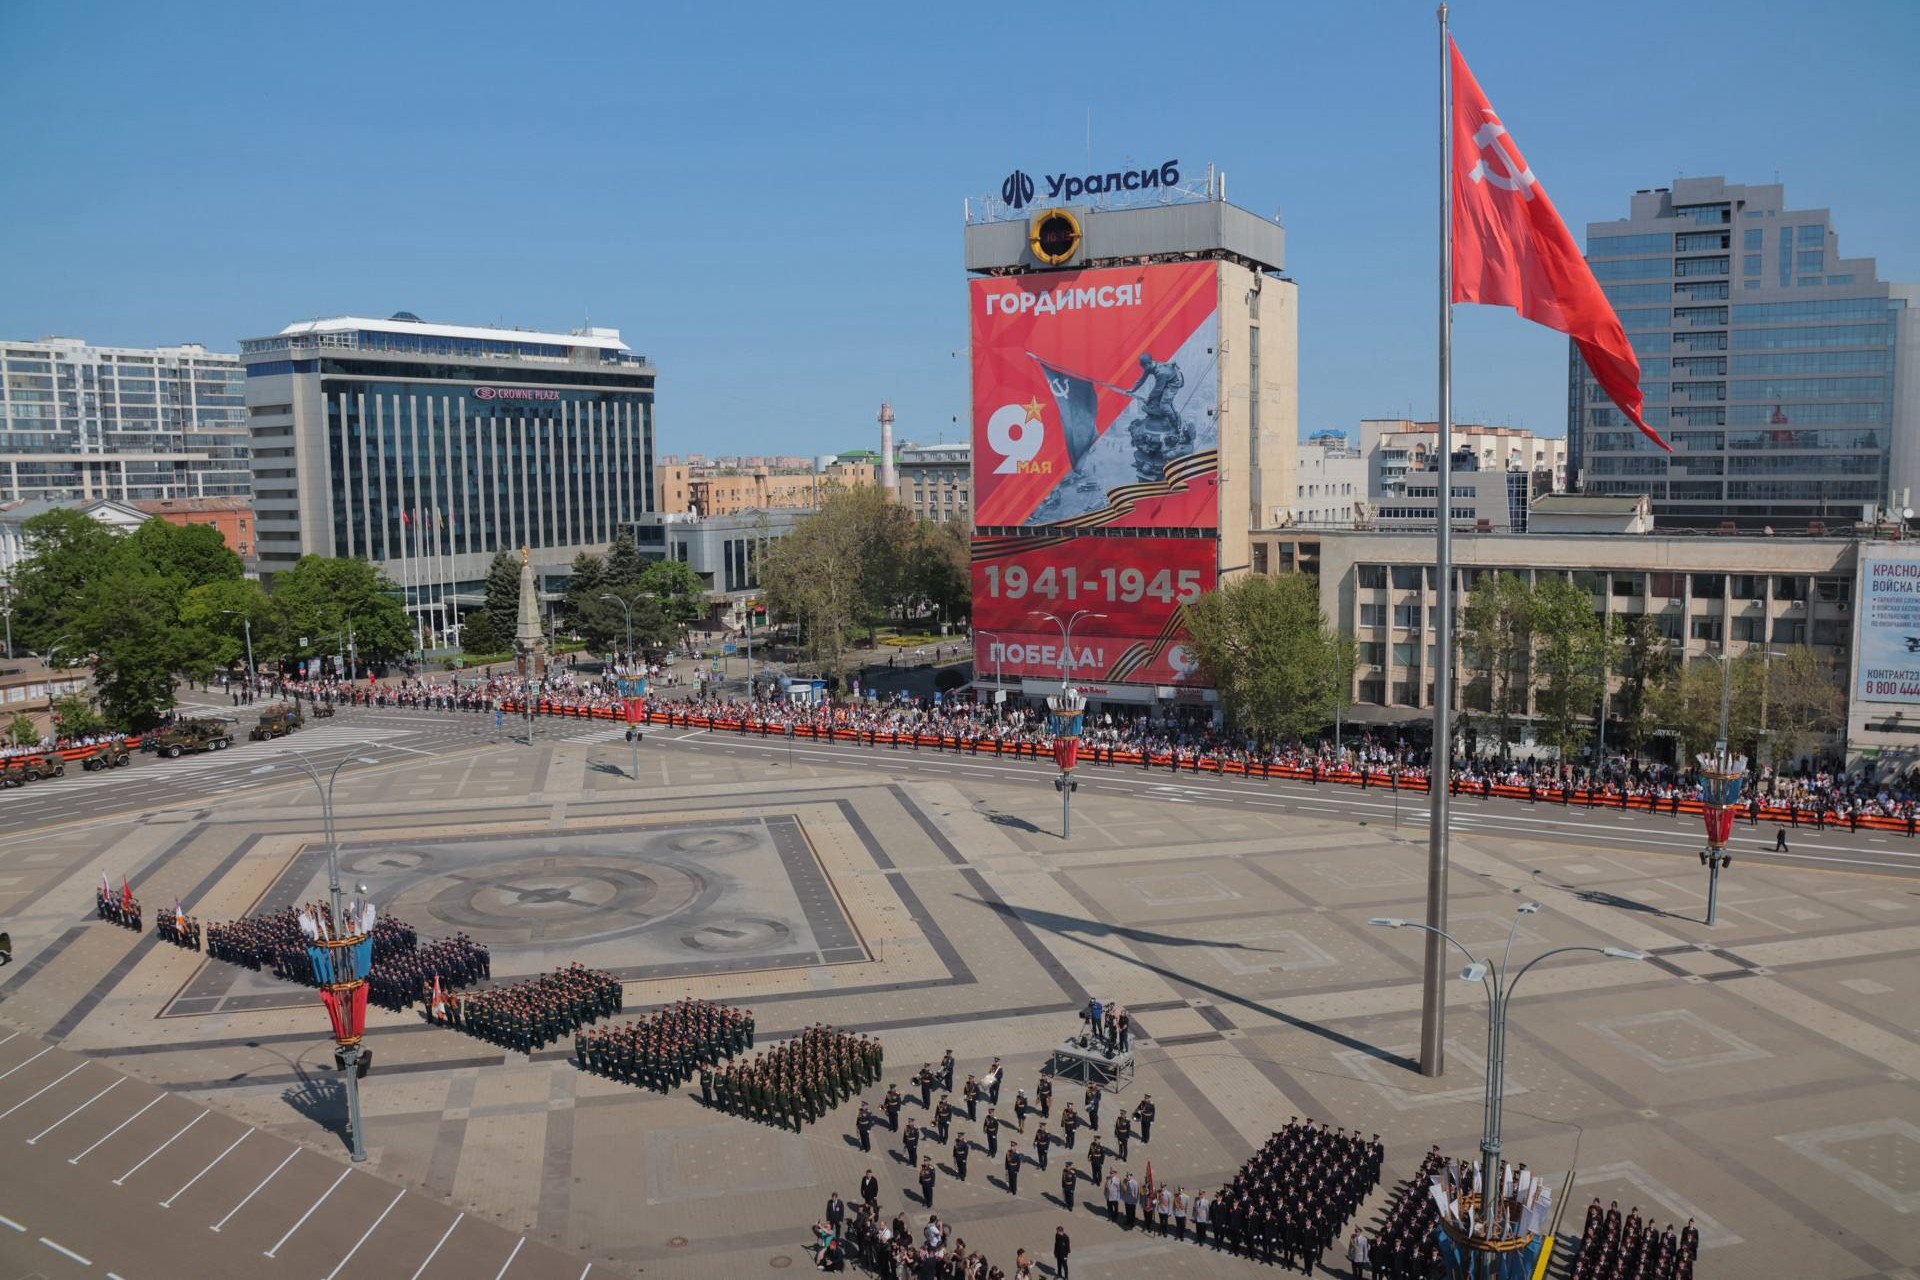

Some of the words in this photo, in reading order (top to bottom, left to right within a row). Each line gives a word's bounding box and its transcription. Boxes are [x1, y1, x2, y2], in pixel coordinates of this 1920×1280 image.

[1045, 159, 1180, 201] Уралсиб
[986, 283, 1143, 316] ГОРДИМСЯ!
[498, 389, 533, 399] CROWNE
[535, 390, 560, 400] PLAZA
[987, 403, 1044, 474] 9
[1017, 461, 1052, 474] МАЯ
[984, 565, 1201, 605] 1941-1945
[1872, 579, 1912, 592] ВОЙСКА
[990, 642, 1104, 670] ПОБЕДА!
[1866, 681, 1873, 693] 8
[1876, 681, 1897, 695] 800
